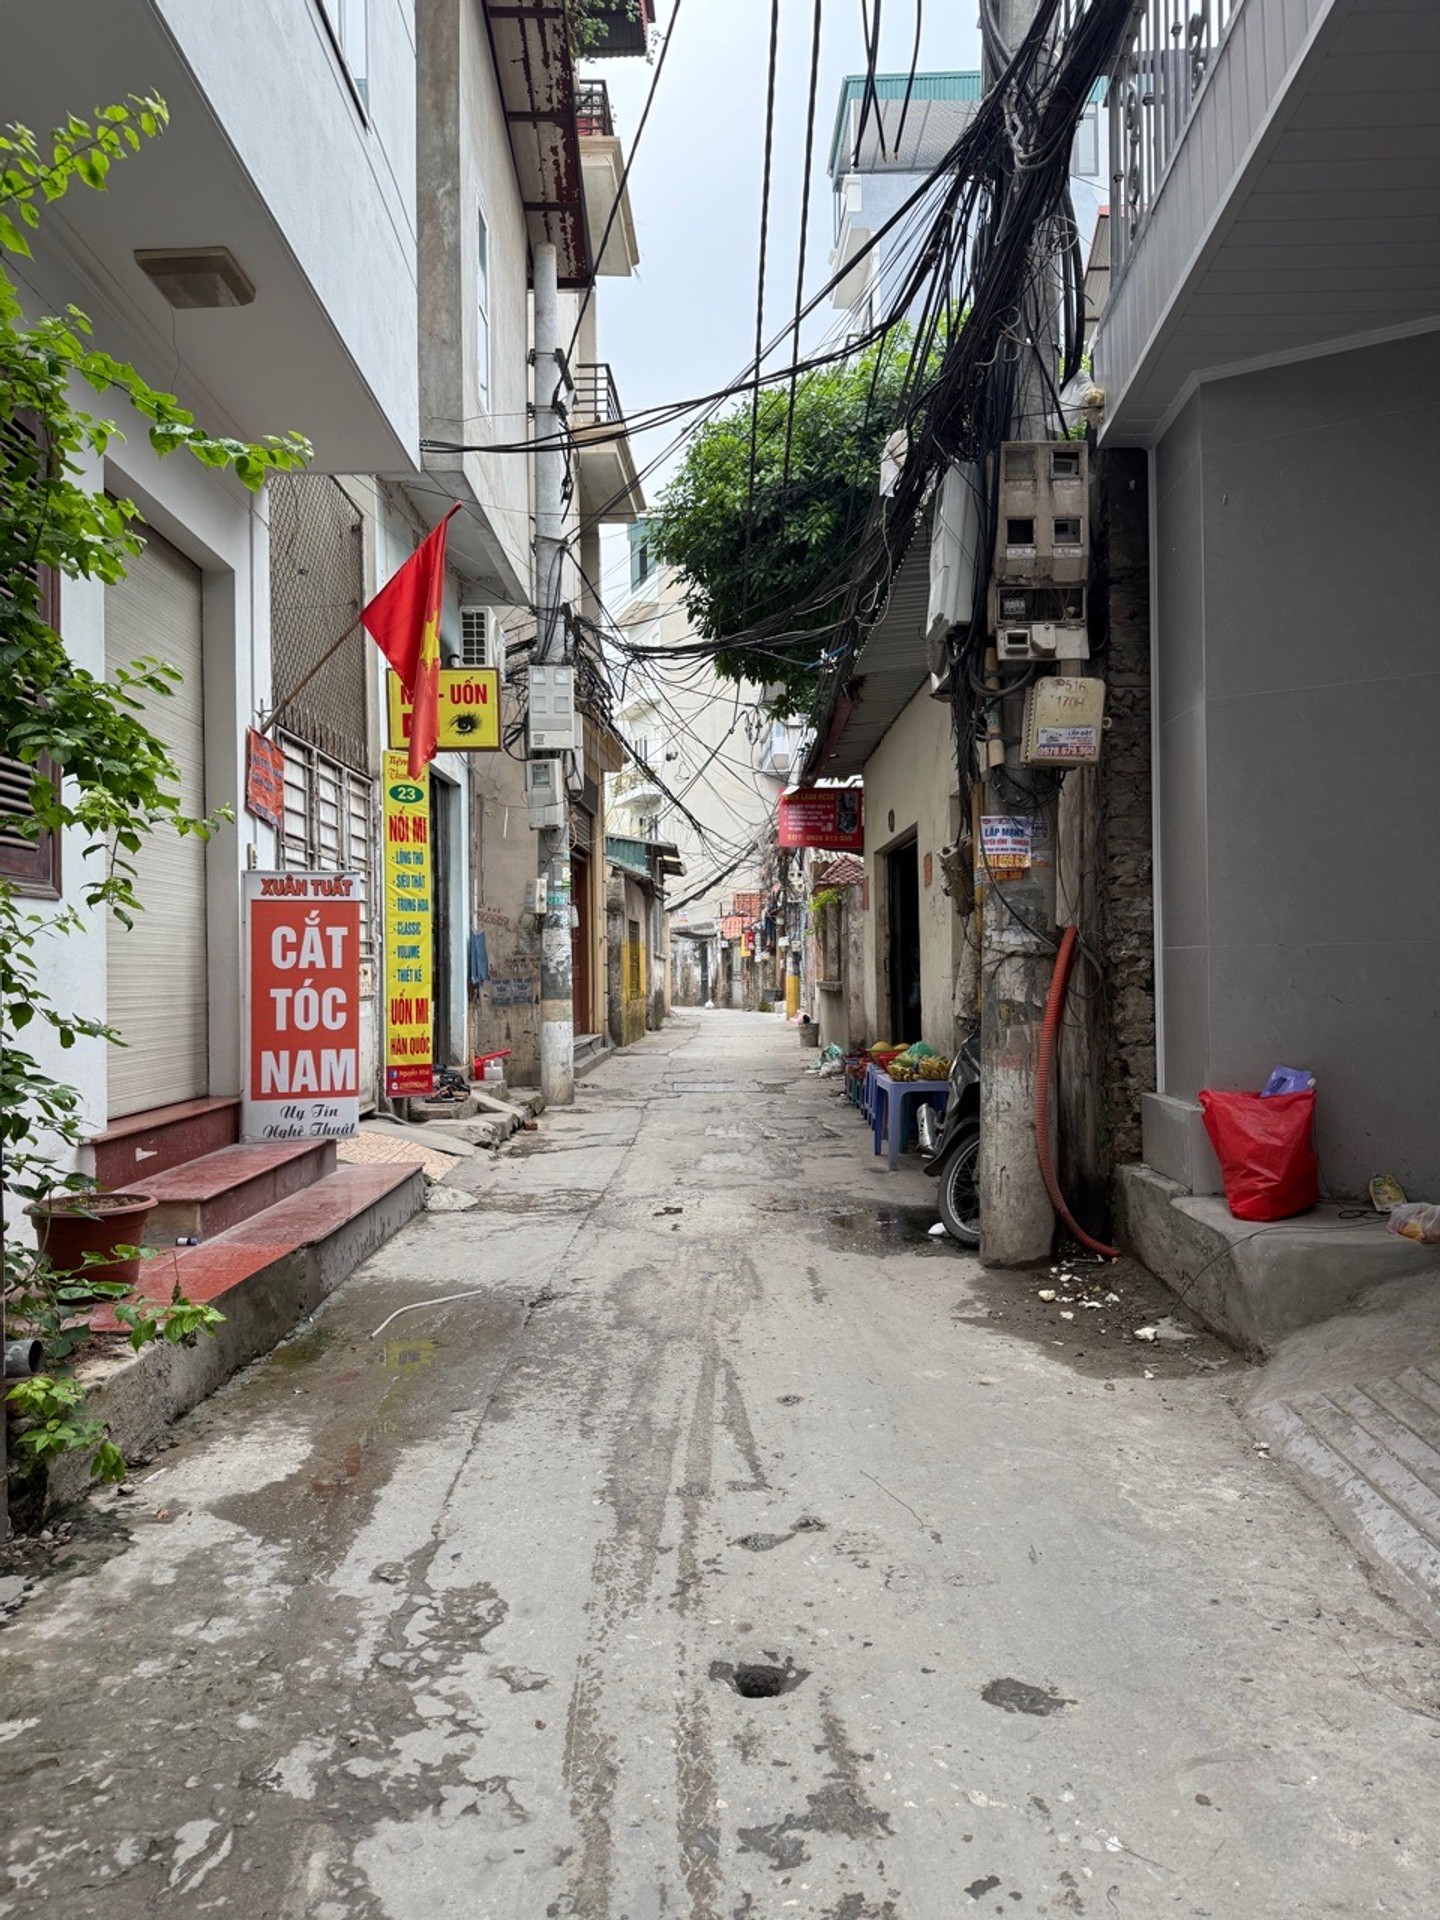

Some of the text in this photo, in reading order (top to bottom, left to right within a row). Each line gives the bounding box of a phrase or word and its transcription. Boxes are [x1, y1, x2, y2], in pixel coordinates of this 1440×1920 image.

[450, 676, 488, 704] UỐN
[397, 787, 416, 800] 23
[389, 806, 427, 843] NỐI MI
[261, 874, 353, 896] XUÂN TUẤT
[271, 909, 348, 970] CẮT
[270, 978, 347, 1031] TÓC
[391, 988, 429, 1025] UỐN MI
[390, 1030, 430, 1056] HÀN QUỐC
[261, 1048, 356, 1094] NAM
